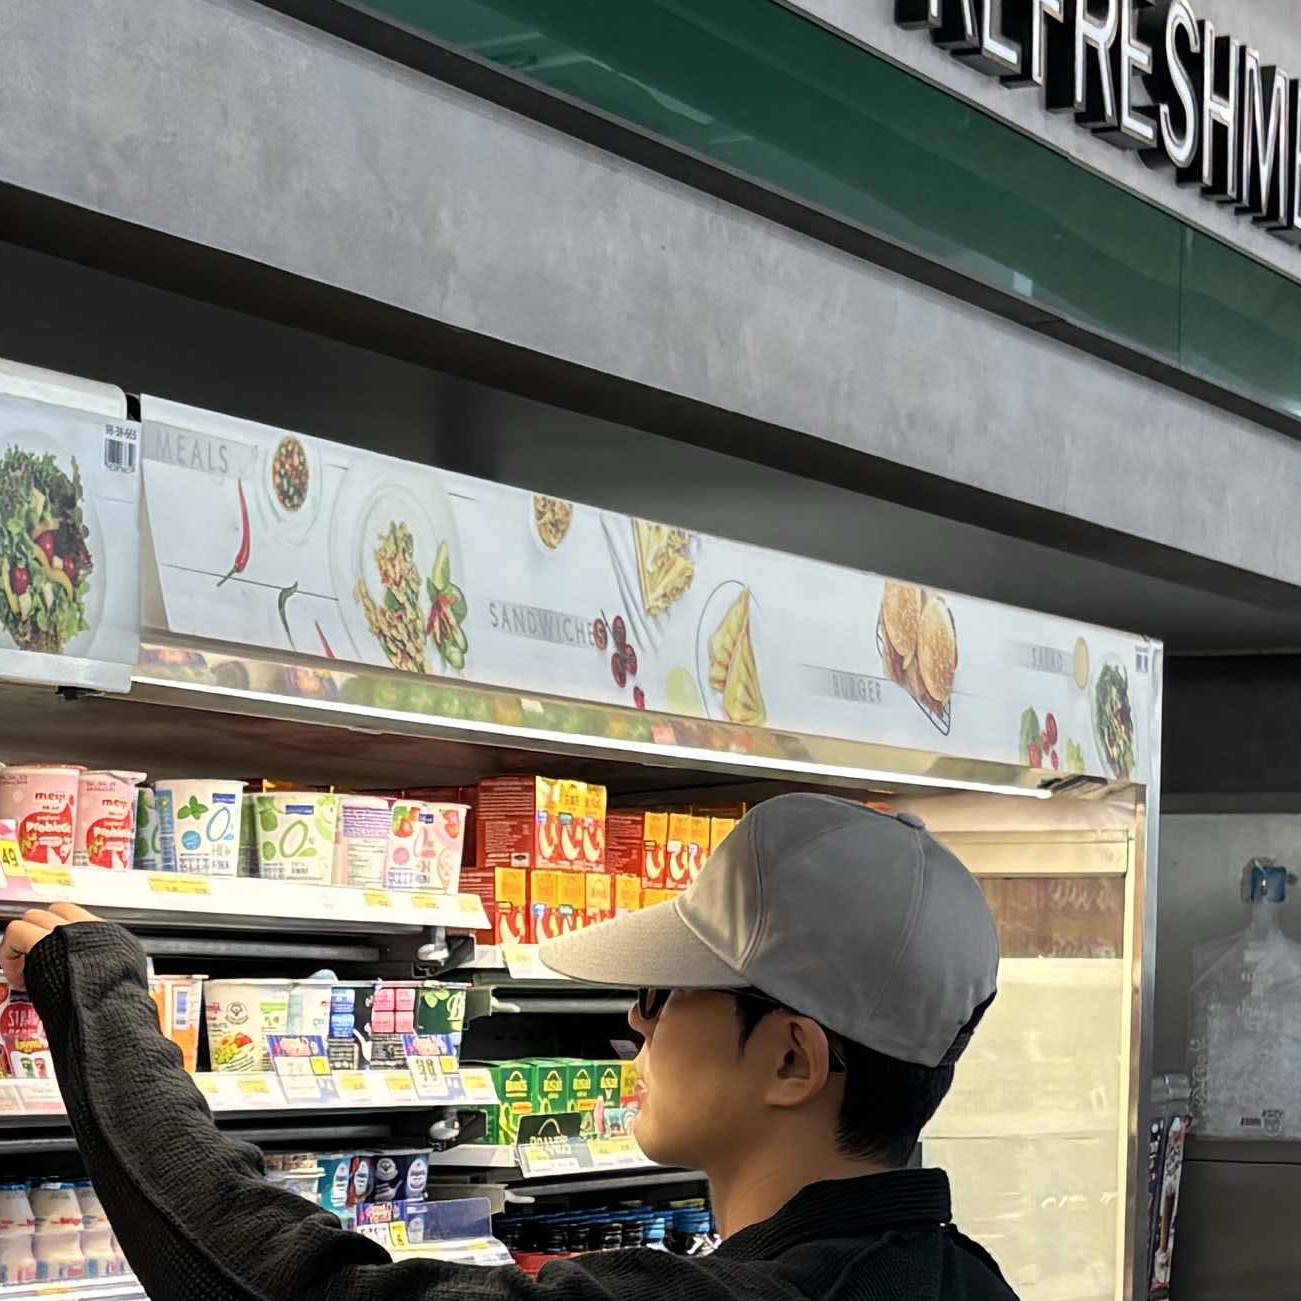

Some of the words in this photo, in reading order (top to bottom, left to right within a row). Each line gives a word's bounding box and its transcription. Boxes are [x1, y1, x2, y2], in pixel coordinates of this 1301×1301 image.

[155, 430, 229, 474] MEALS
[488, 604, 606, 650] SANDWICHE
[1031, 650, 1063, 673] SALAD
[832, 675, 883, 705] BURGER
